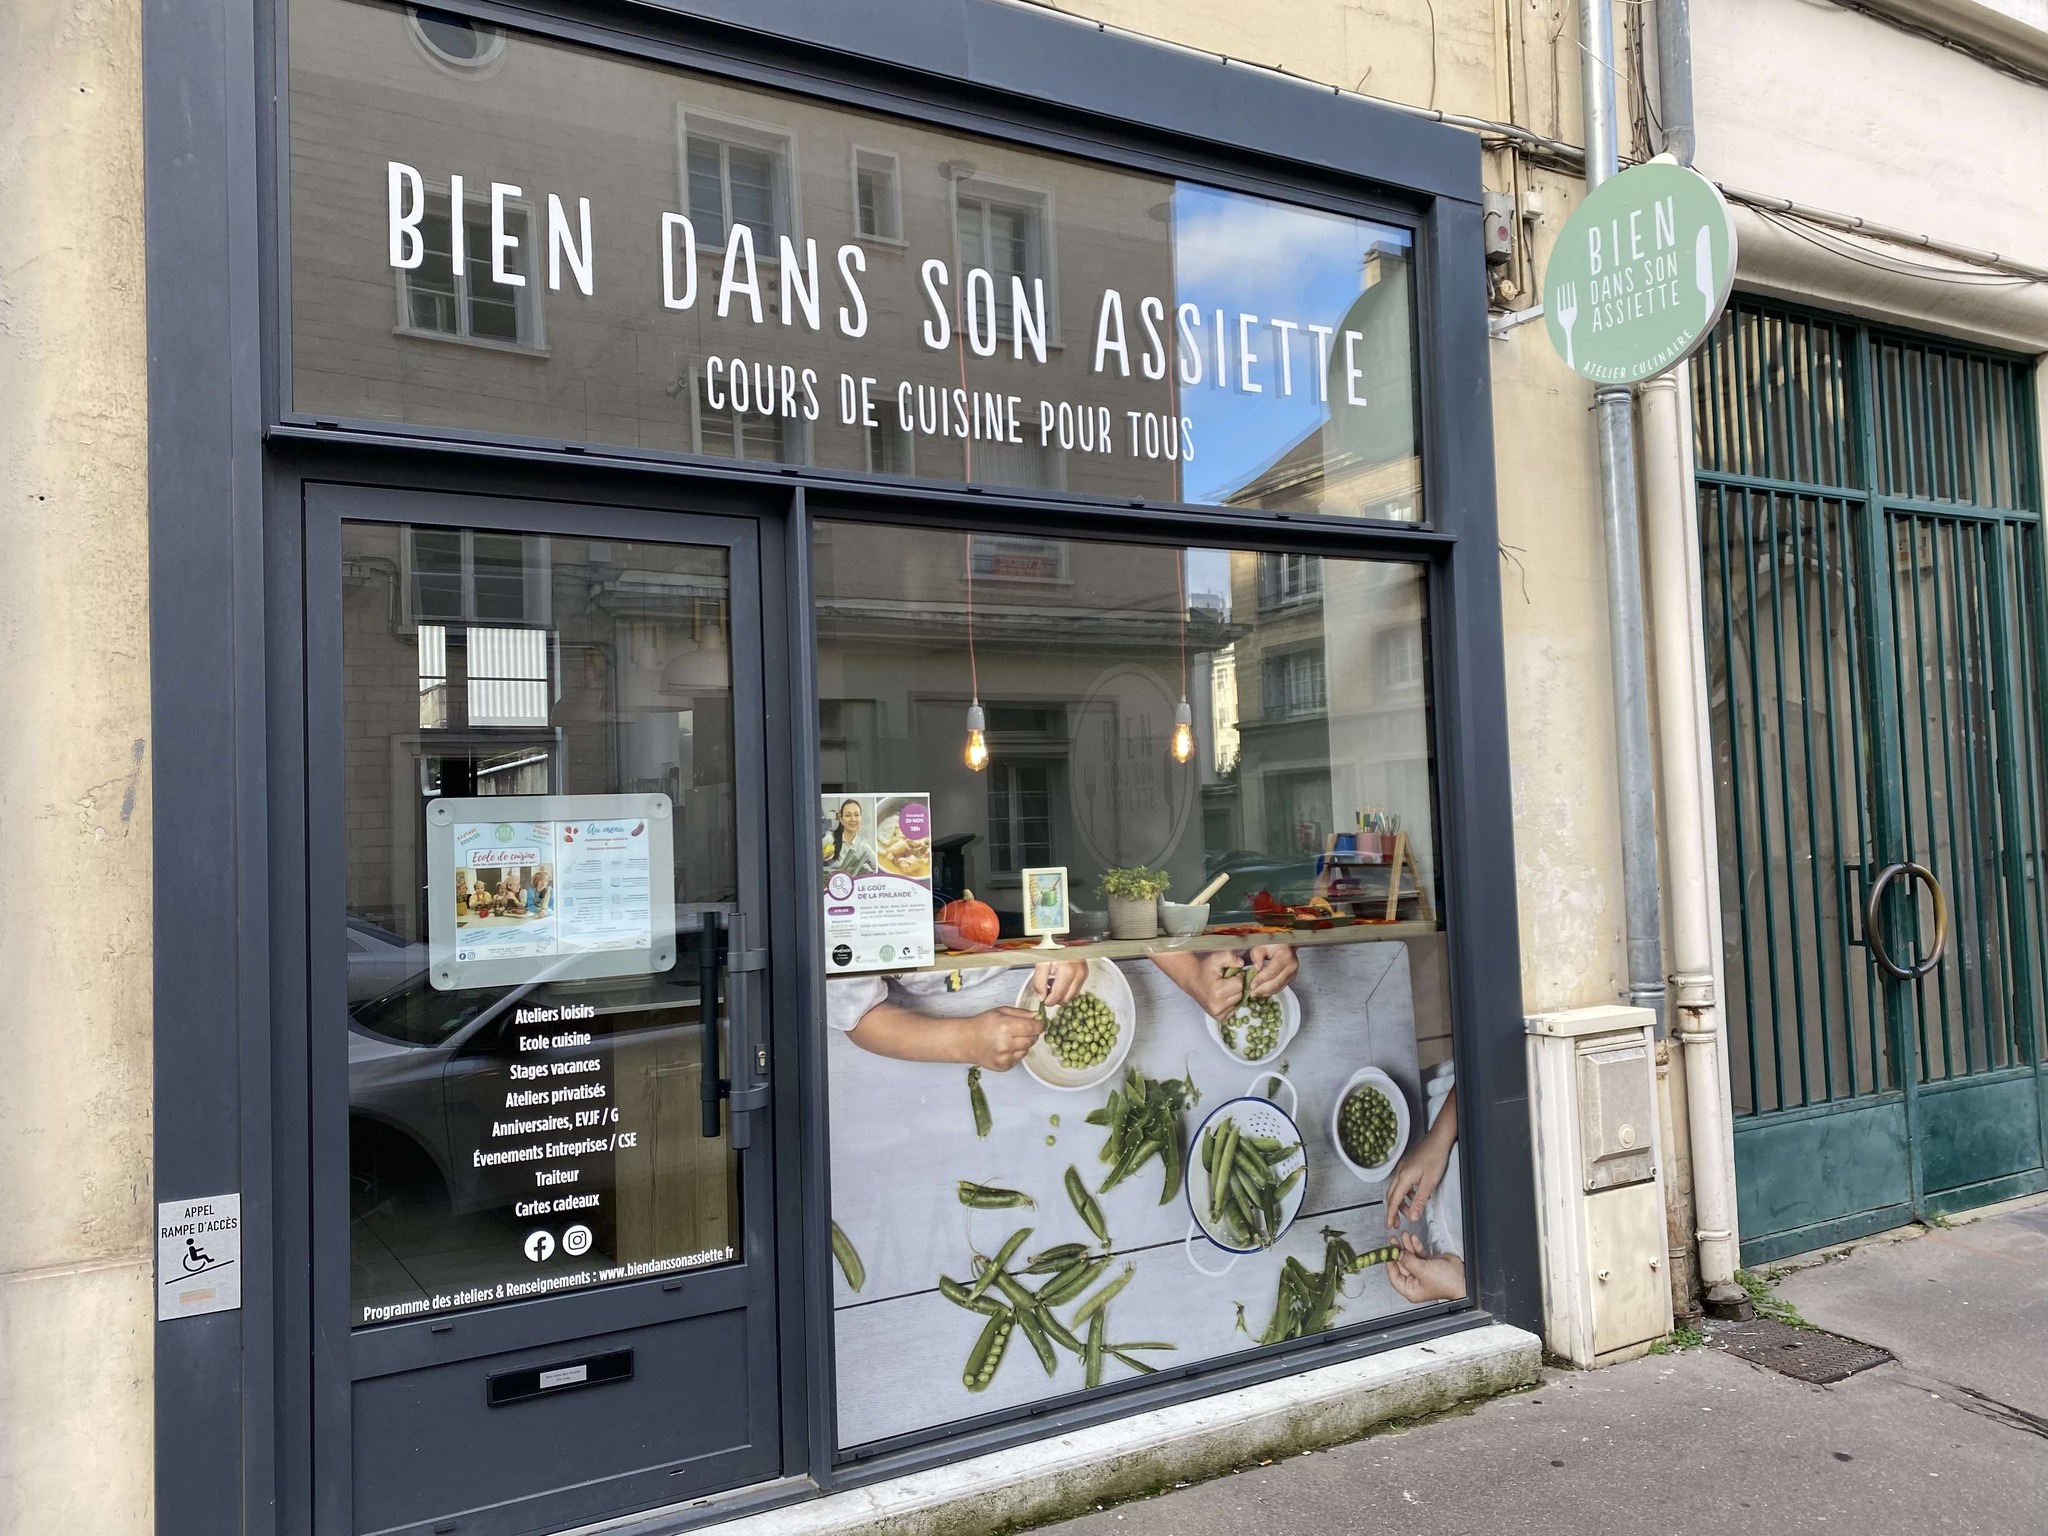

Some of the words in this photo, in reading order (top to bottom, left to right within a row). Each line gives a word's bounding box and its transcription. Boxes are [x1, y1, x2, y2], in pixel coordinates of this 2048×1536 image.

[1588, 195, 1676, 276] BIEN
[387, 161, 593, 296] BIEN
[660, 211, 869, 338] DANS
[921, 258, 1047, 363] SON
[1094, 289, 1368, 407] ASSIETTE
[1590, 266, 1634, 305] DANS
[1645, 251, 1678, 286] SON
[1592, 279, 1680, 333] ASSIETTE
[1582, 360, 1628, 380] ATELIER
[1632, 328, 1694, 377] CULINAIRE
[706, 355, 820, 421] COURS
[840, 373, 878, 428] DE
[898, 380, 1024, 443] CUISINE
[1040, 400, 1112, 454] POUR
[1127, 411, 1195, 461] TOUS
[472, 850, 495, 863] Ecole
[515, 1007, 559, 1025] Ateliers
[560, 1003, 595, 1020] loisirs
[519, 1036, 549, 1052] Ecole
[551, 1031, 591, 1048] cuisine
[510, 1063, 549, 1081] Stages
[551, 1058, 601, 1076] vacances
[505, 1090, 549, 1109] Ateliers
[551, 1082, 606, 1106] privatisés
[492, 1116, 573, 1137] Anniversaires,
[575, 1109, 600, 1127] EVJF
[601, 1107, 609, 1126] /
[610, 1108, 619, 1123] G
[473, 1146, 544, 1168] Évenements
[546, 1137, 608, 1158] Entreprises
[609, 1133, 617, 1152] /
[617, 1132, 637, 1149] CSE
[535, 1169, 580, 1187] Traiteur
[184, 1204, 215, 1218] APPEL
[515, 1200, 550, 1217] Cartes
[552, 1193, 600, 1211] cadeaux
[161, 1223, 195, 1238] RAMPE
[198, 1216, 238, 1234] D'ACCÈS
[363, 1299, 430, 1322] Programme
[432, 1294, 452, 1310] des
[453, 1285, 494, 1305] ateliers
[495, 1284, 505, 1299] &
[506, 1271, 591, 1298] Renseignements
